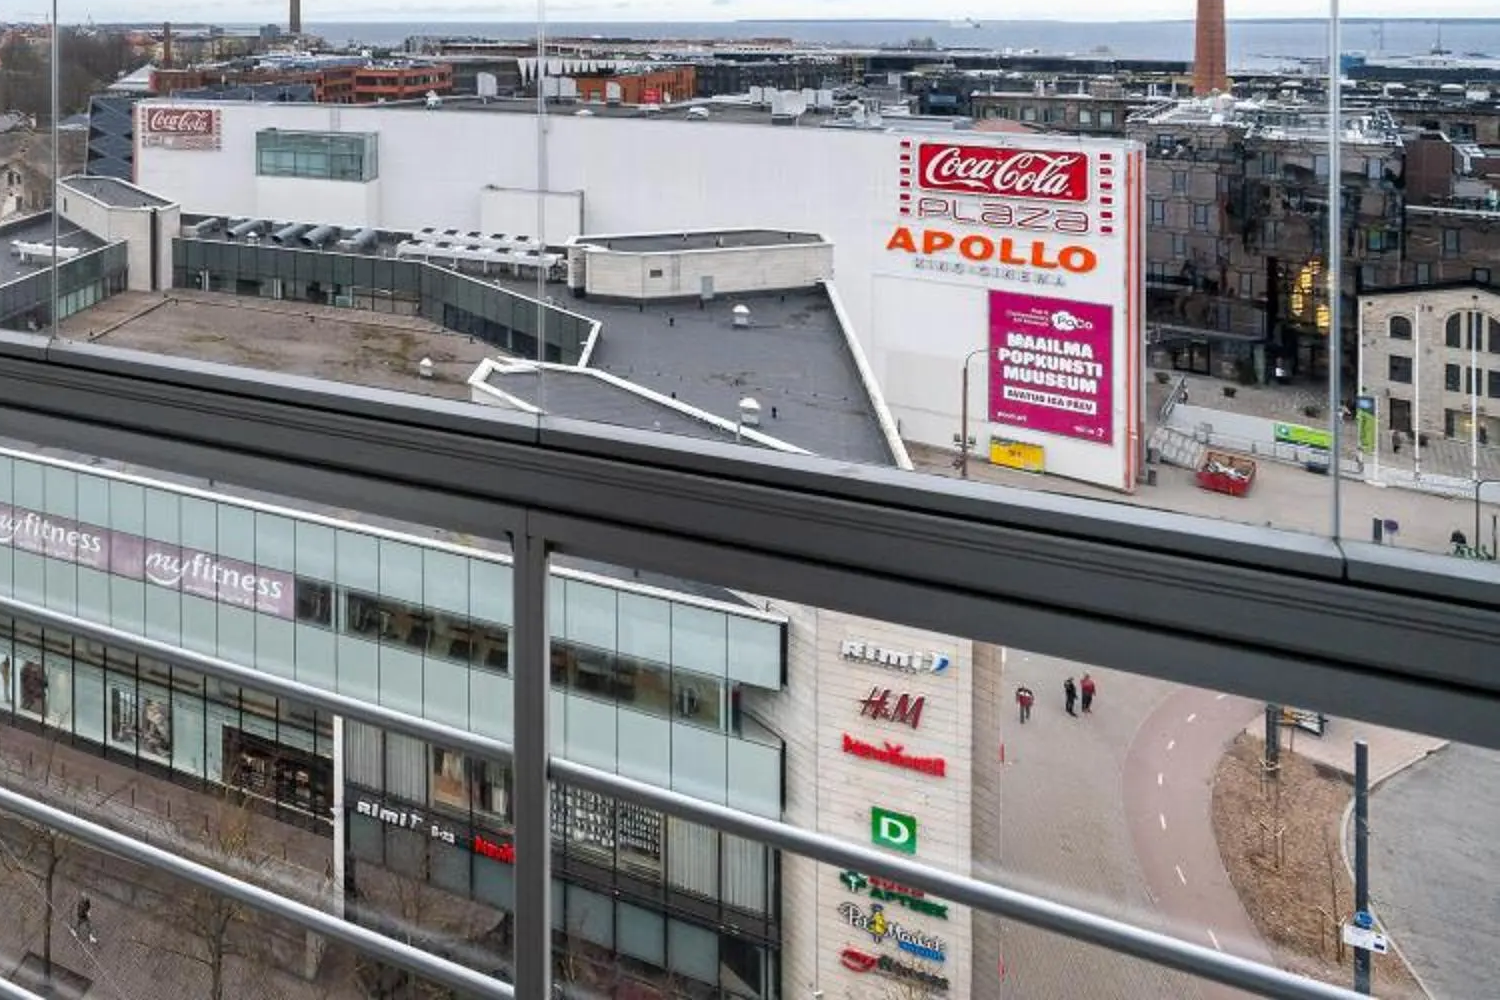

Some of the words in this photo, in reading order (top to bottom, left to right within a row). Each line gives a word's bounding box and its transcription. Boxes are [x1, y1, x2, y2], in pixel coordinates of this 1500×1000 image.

[925, 147, 1081, 195] Coca-Cola
[887, 226, 1098, 274] APOLLO
[998, 347, 1102, 378] POPKUNSTI
[1007, 332, 1094, 359] MAAILMA
[1003, 365, 1097, 394] MUUSEUM
[145, 552, 283, 599] myfitness
[859, 685, 925, 730] H&M
[880, 816, 909, 843] D
